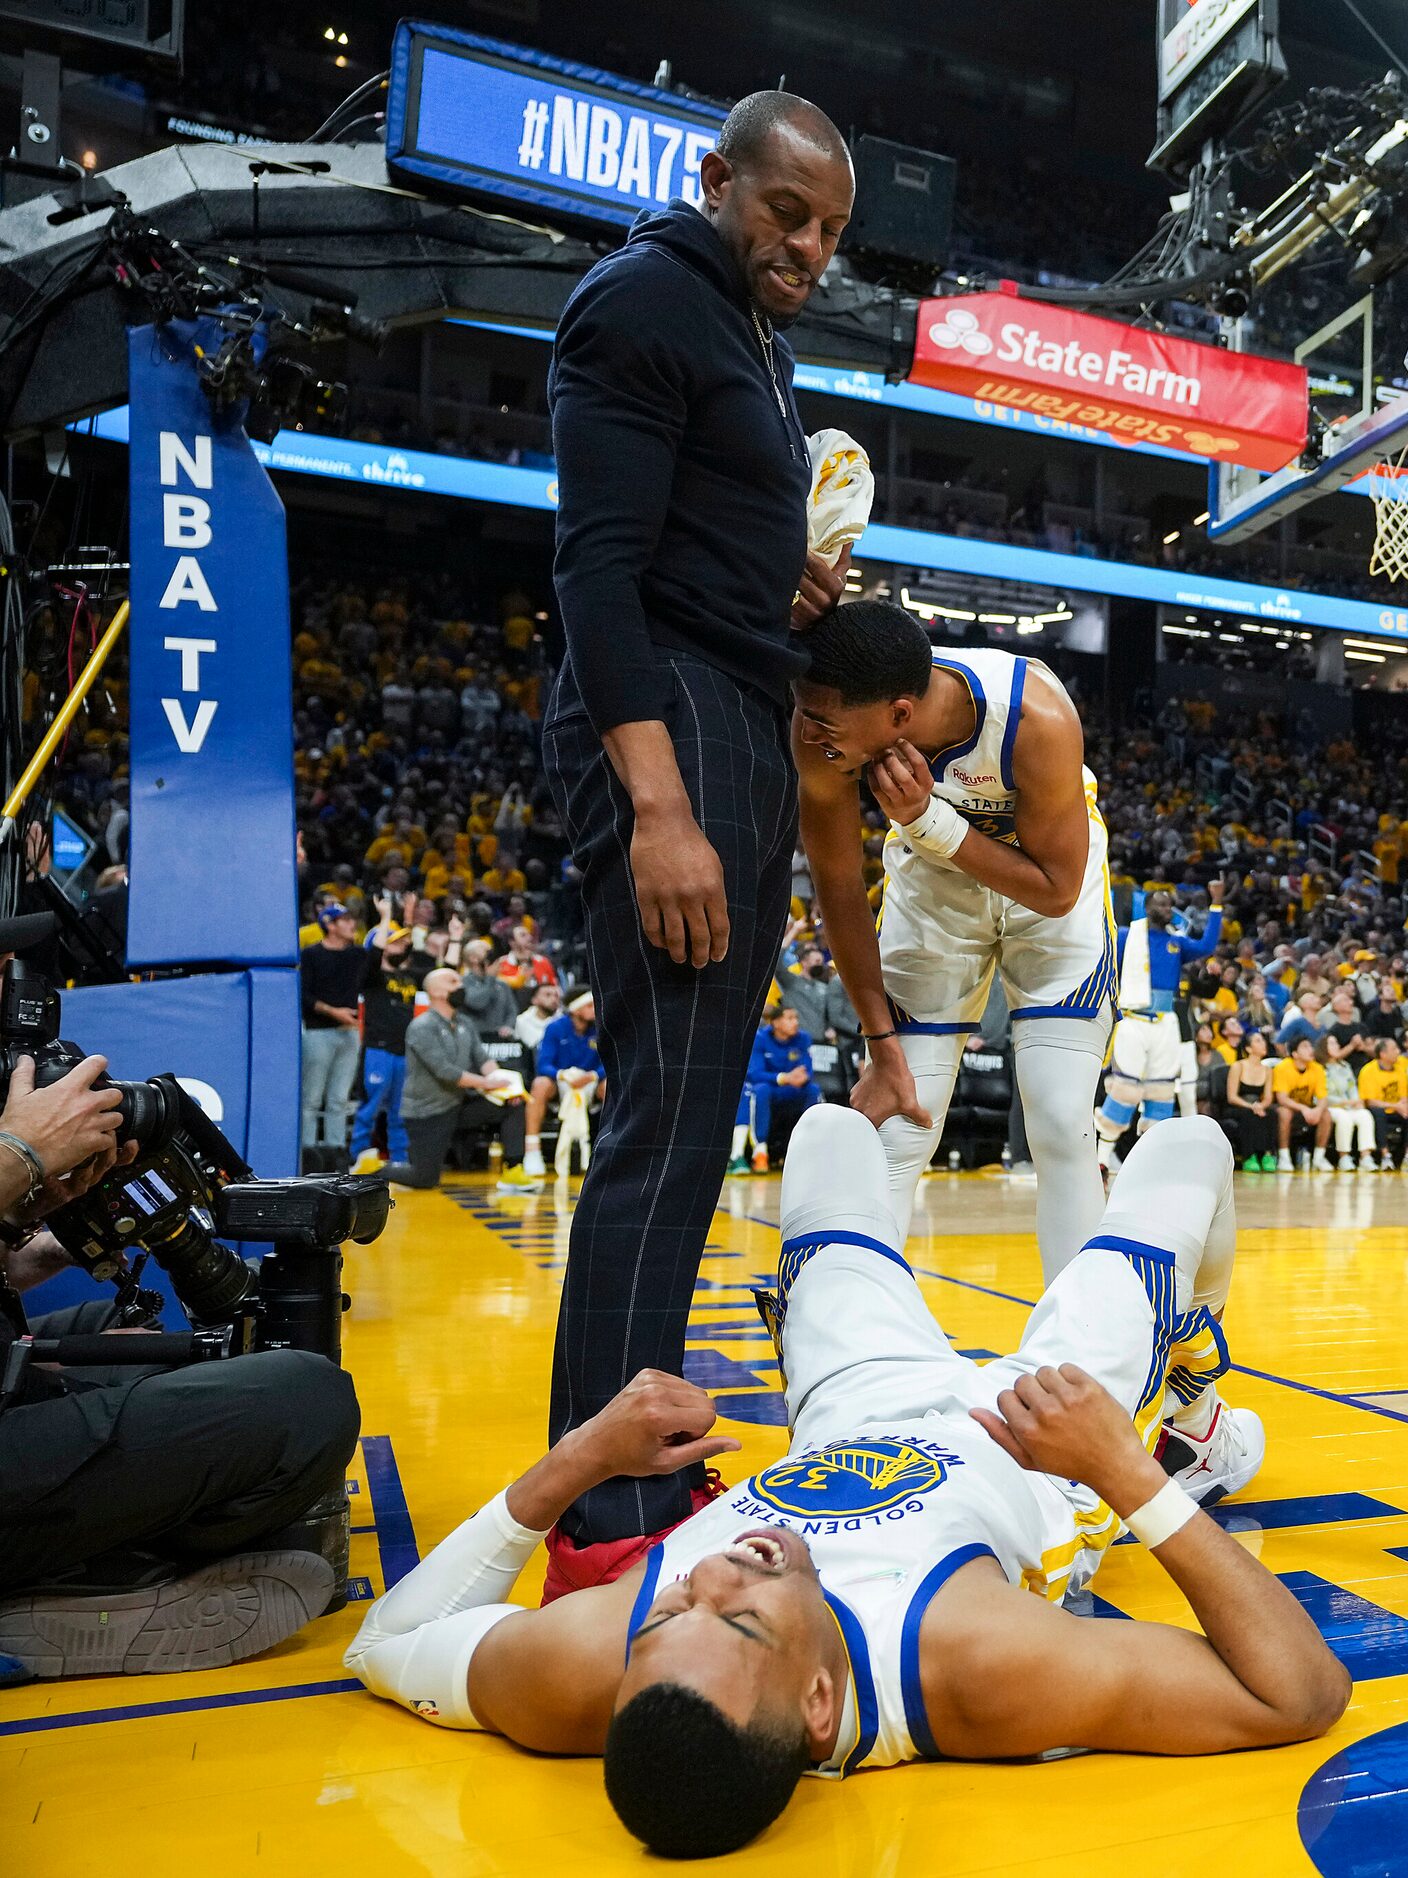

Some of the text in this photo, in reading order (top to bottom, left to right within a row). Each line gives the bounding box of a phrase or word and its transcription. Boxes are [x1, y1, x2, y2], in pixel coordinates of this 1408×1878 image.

[159, 430, 218, 753] NBA TV
[953, 768, 997, 785] Rakuten
[962, 798, 1014, 812] STATE
[766, 1465, 840, 1491] 32
[731, 1495, 924, 1536] GOLDEN STATE
